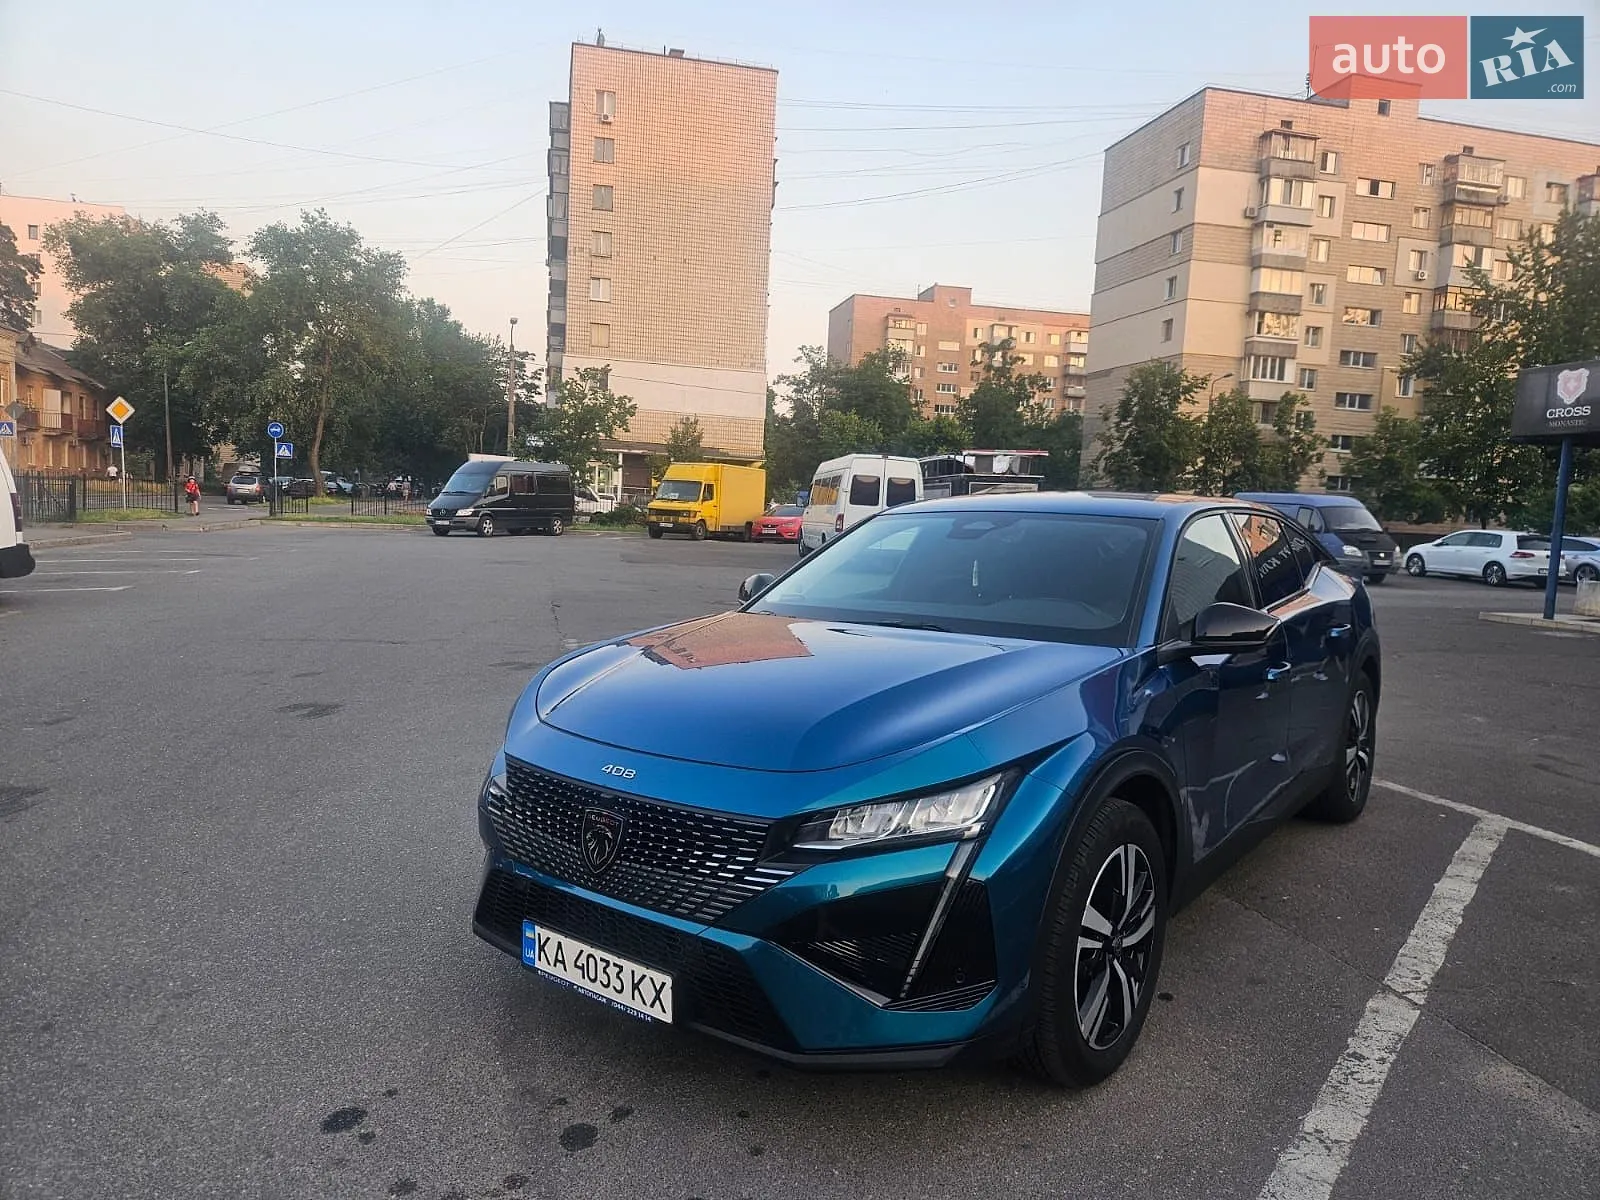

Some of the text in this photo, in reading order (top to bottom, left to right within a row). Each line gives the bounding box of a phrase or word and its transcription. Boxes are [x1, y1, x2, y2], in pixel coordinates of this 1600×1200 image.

[601, 764, 636, 779] 408
[525, 947, 535, 960] UA
[537, 933, 667, 1014] KA 4033 KX
